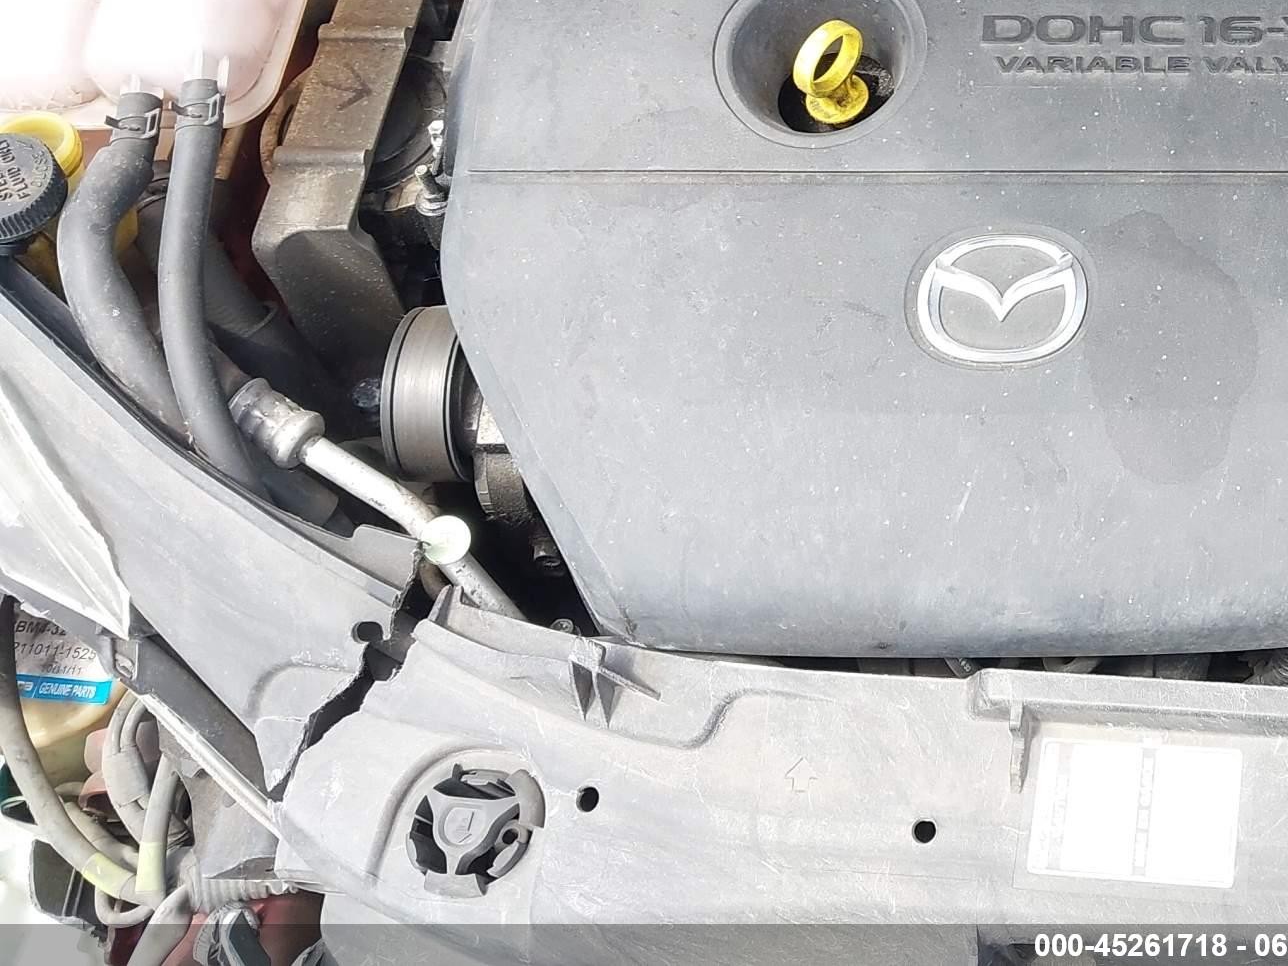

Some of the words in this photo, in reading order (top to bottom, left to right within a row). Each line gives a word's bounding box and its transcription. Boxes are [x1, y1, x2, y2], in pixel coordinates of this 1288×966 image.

[981, 15, 1186, 44] DOHC
[996, 56, 1191, 74] VARIABLE
[7, 167, 31, 200] FLUID
[39, 682, 72, 696] GENUINE
[72, 685, 97, 699] PARTS
